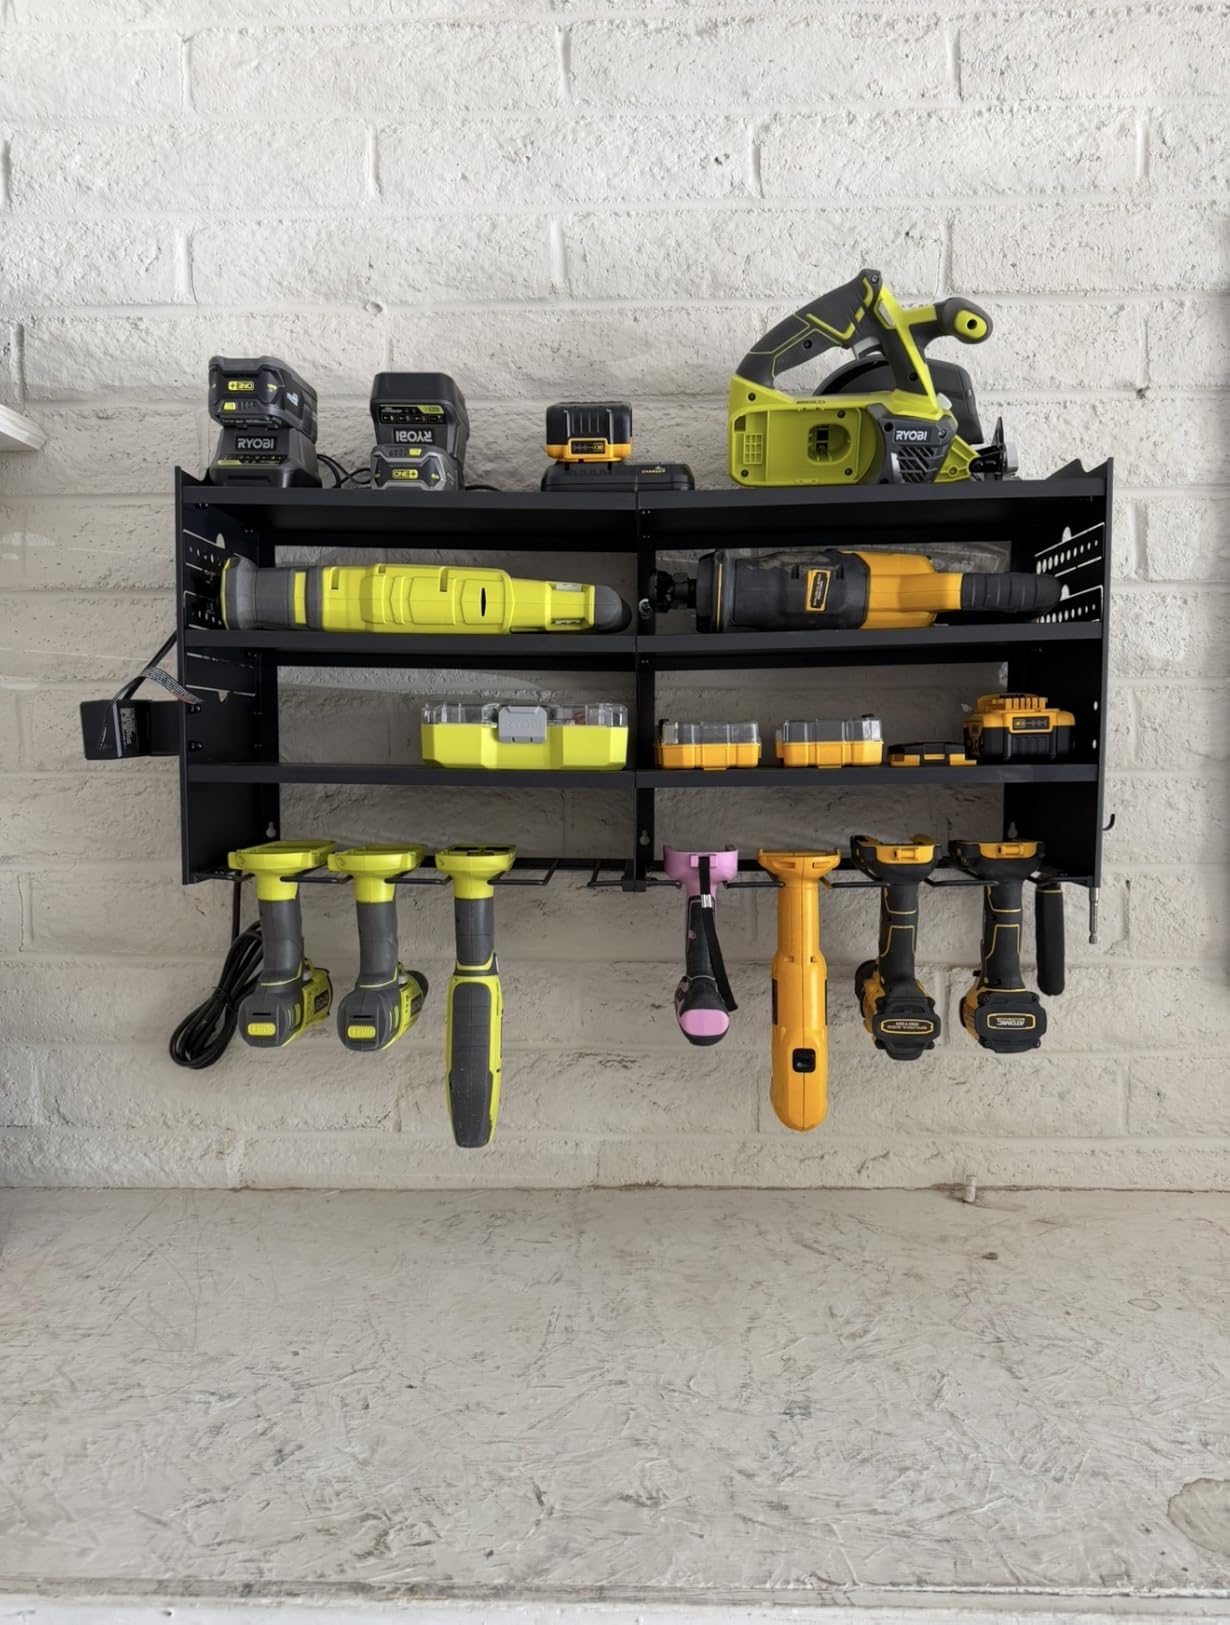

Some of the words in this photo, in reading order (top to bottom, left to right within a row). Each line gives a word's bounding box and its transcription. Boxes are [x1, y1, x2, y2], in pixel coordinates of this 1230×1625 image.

[395, 431, 433, 442] RYOBI
[895, 430, 928, 441] RYOBI
[237, 438, 274, 449] RYOBI
[392, 469, 418, 479] ONE+
